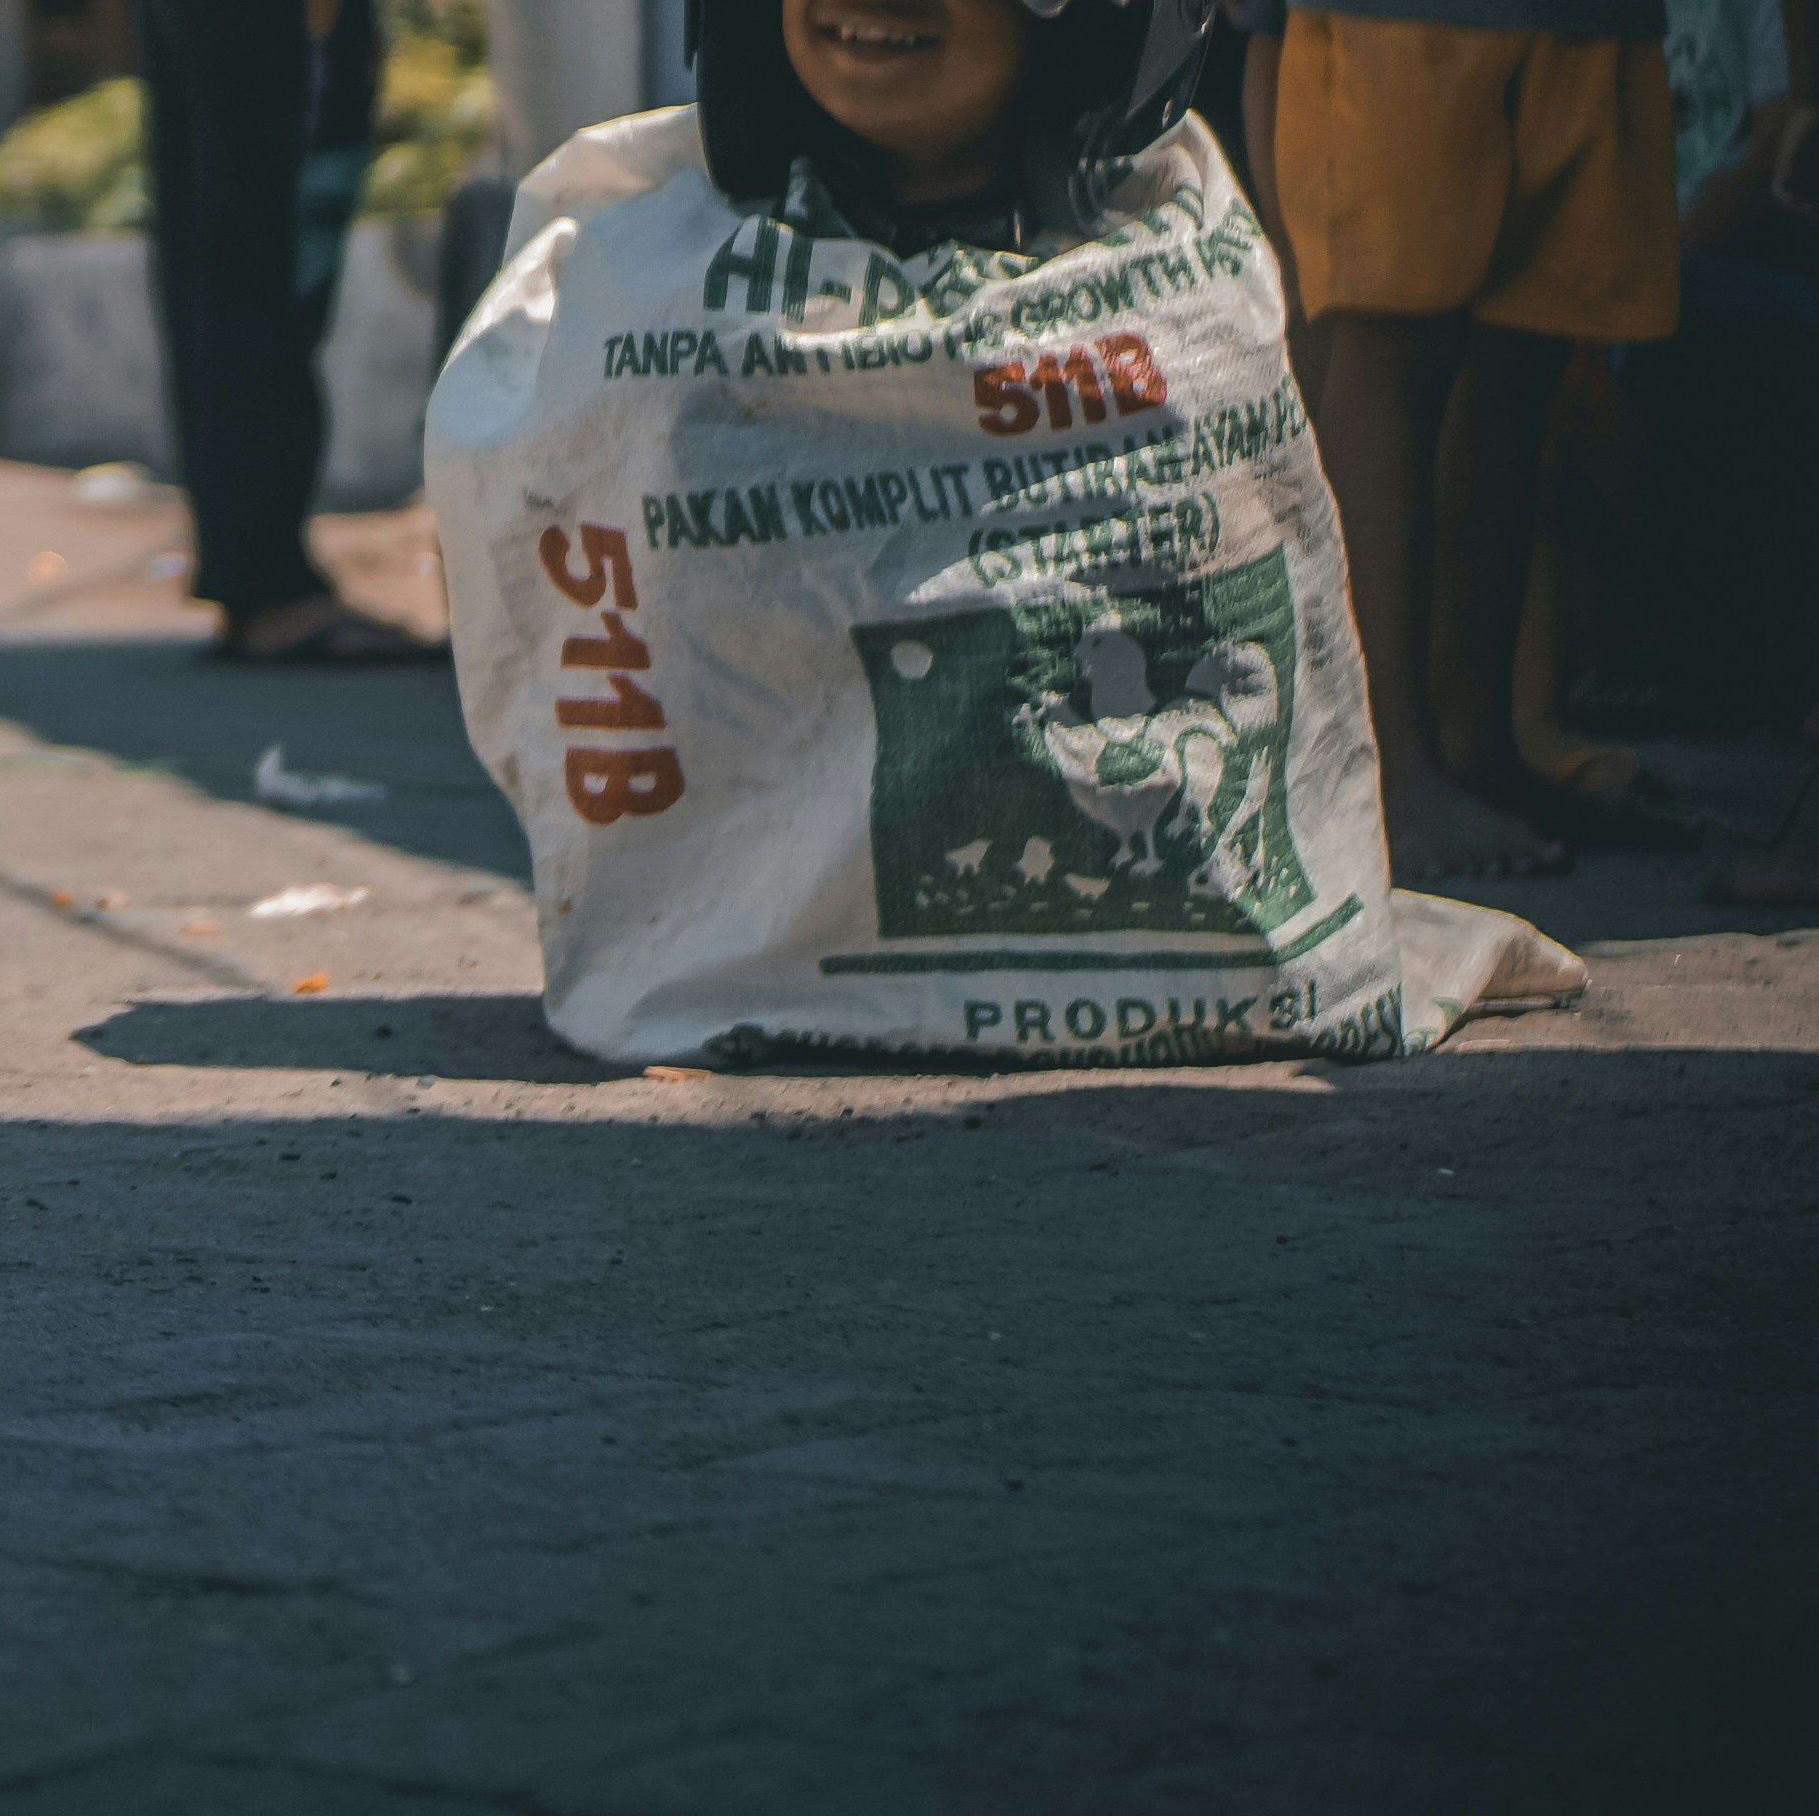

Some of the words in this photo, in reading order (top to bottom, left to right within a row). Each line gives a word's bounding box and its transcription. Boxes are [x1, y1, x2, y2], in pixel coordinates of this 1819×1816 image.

[603, 329, 730, 378] TANPA
[973, 331, 1168, 437] 511B
[641, 486, 787, 550] PAKAN
[790, 461, 974, 536] KOMPLIT
[539, 520, 686, 826] 511B
[965, 982, 1319, 1043] PRODUKSI
